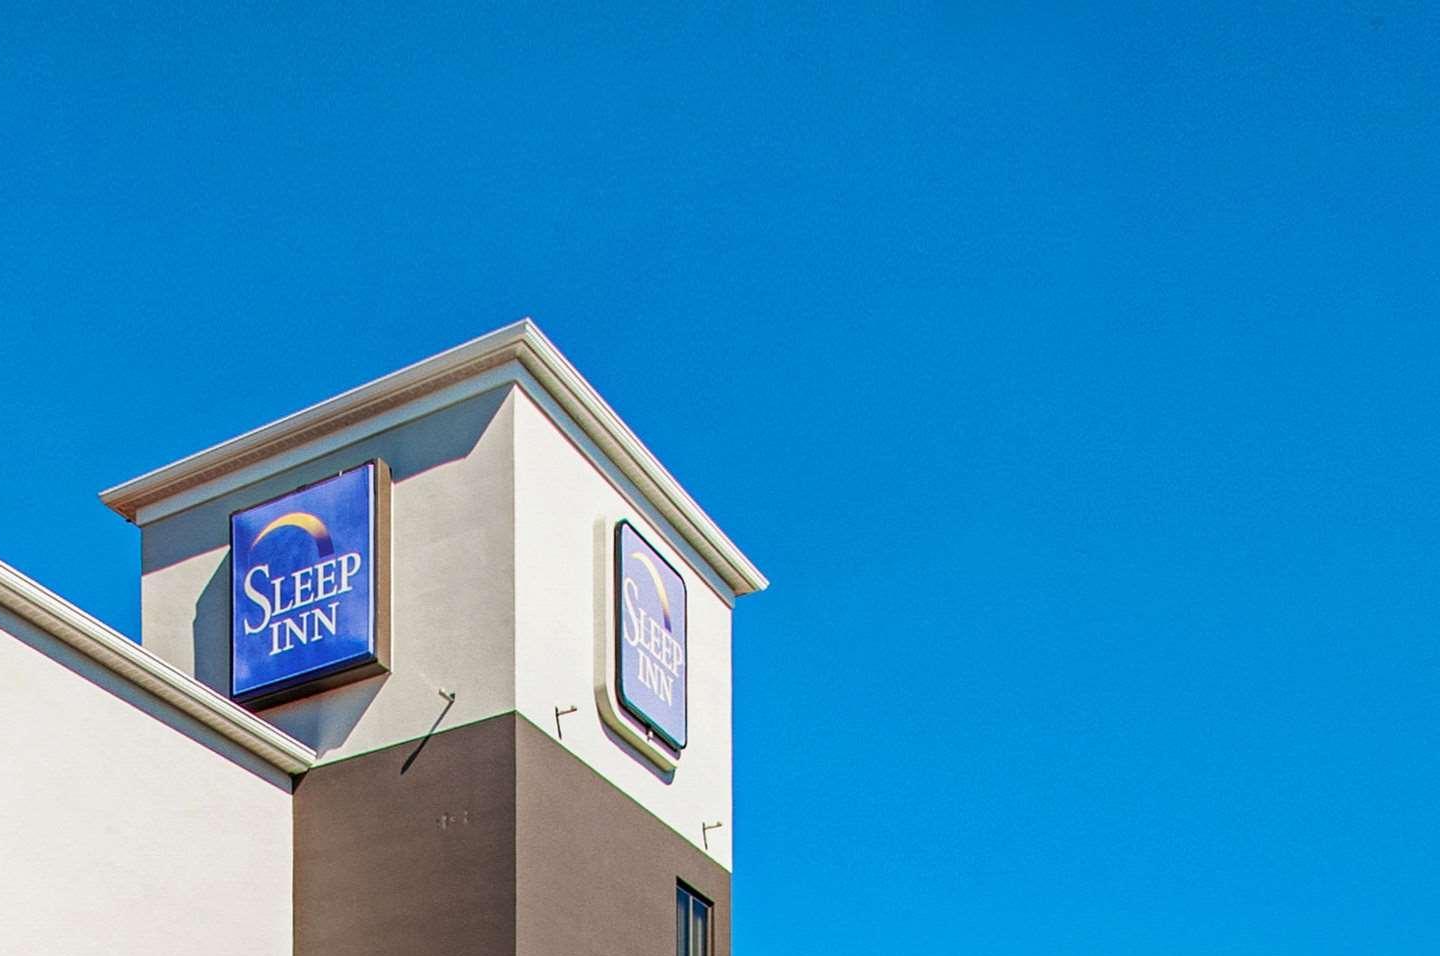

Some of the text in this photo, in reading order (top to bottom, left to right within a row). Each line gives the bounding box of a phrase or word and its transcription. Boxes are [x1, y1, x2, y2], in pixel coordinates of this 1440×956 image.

[244, 553, 361, 635] SLEEP
[269, 602, 340, 655] INN
[624, 577, 683, 677] SLEEP
[637, 649, 674, 706] INN
